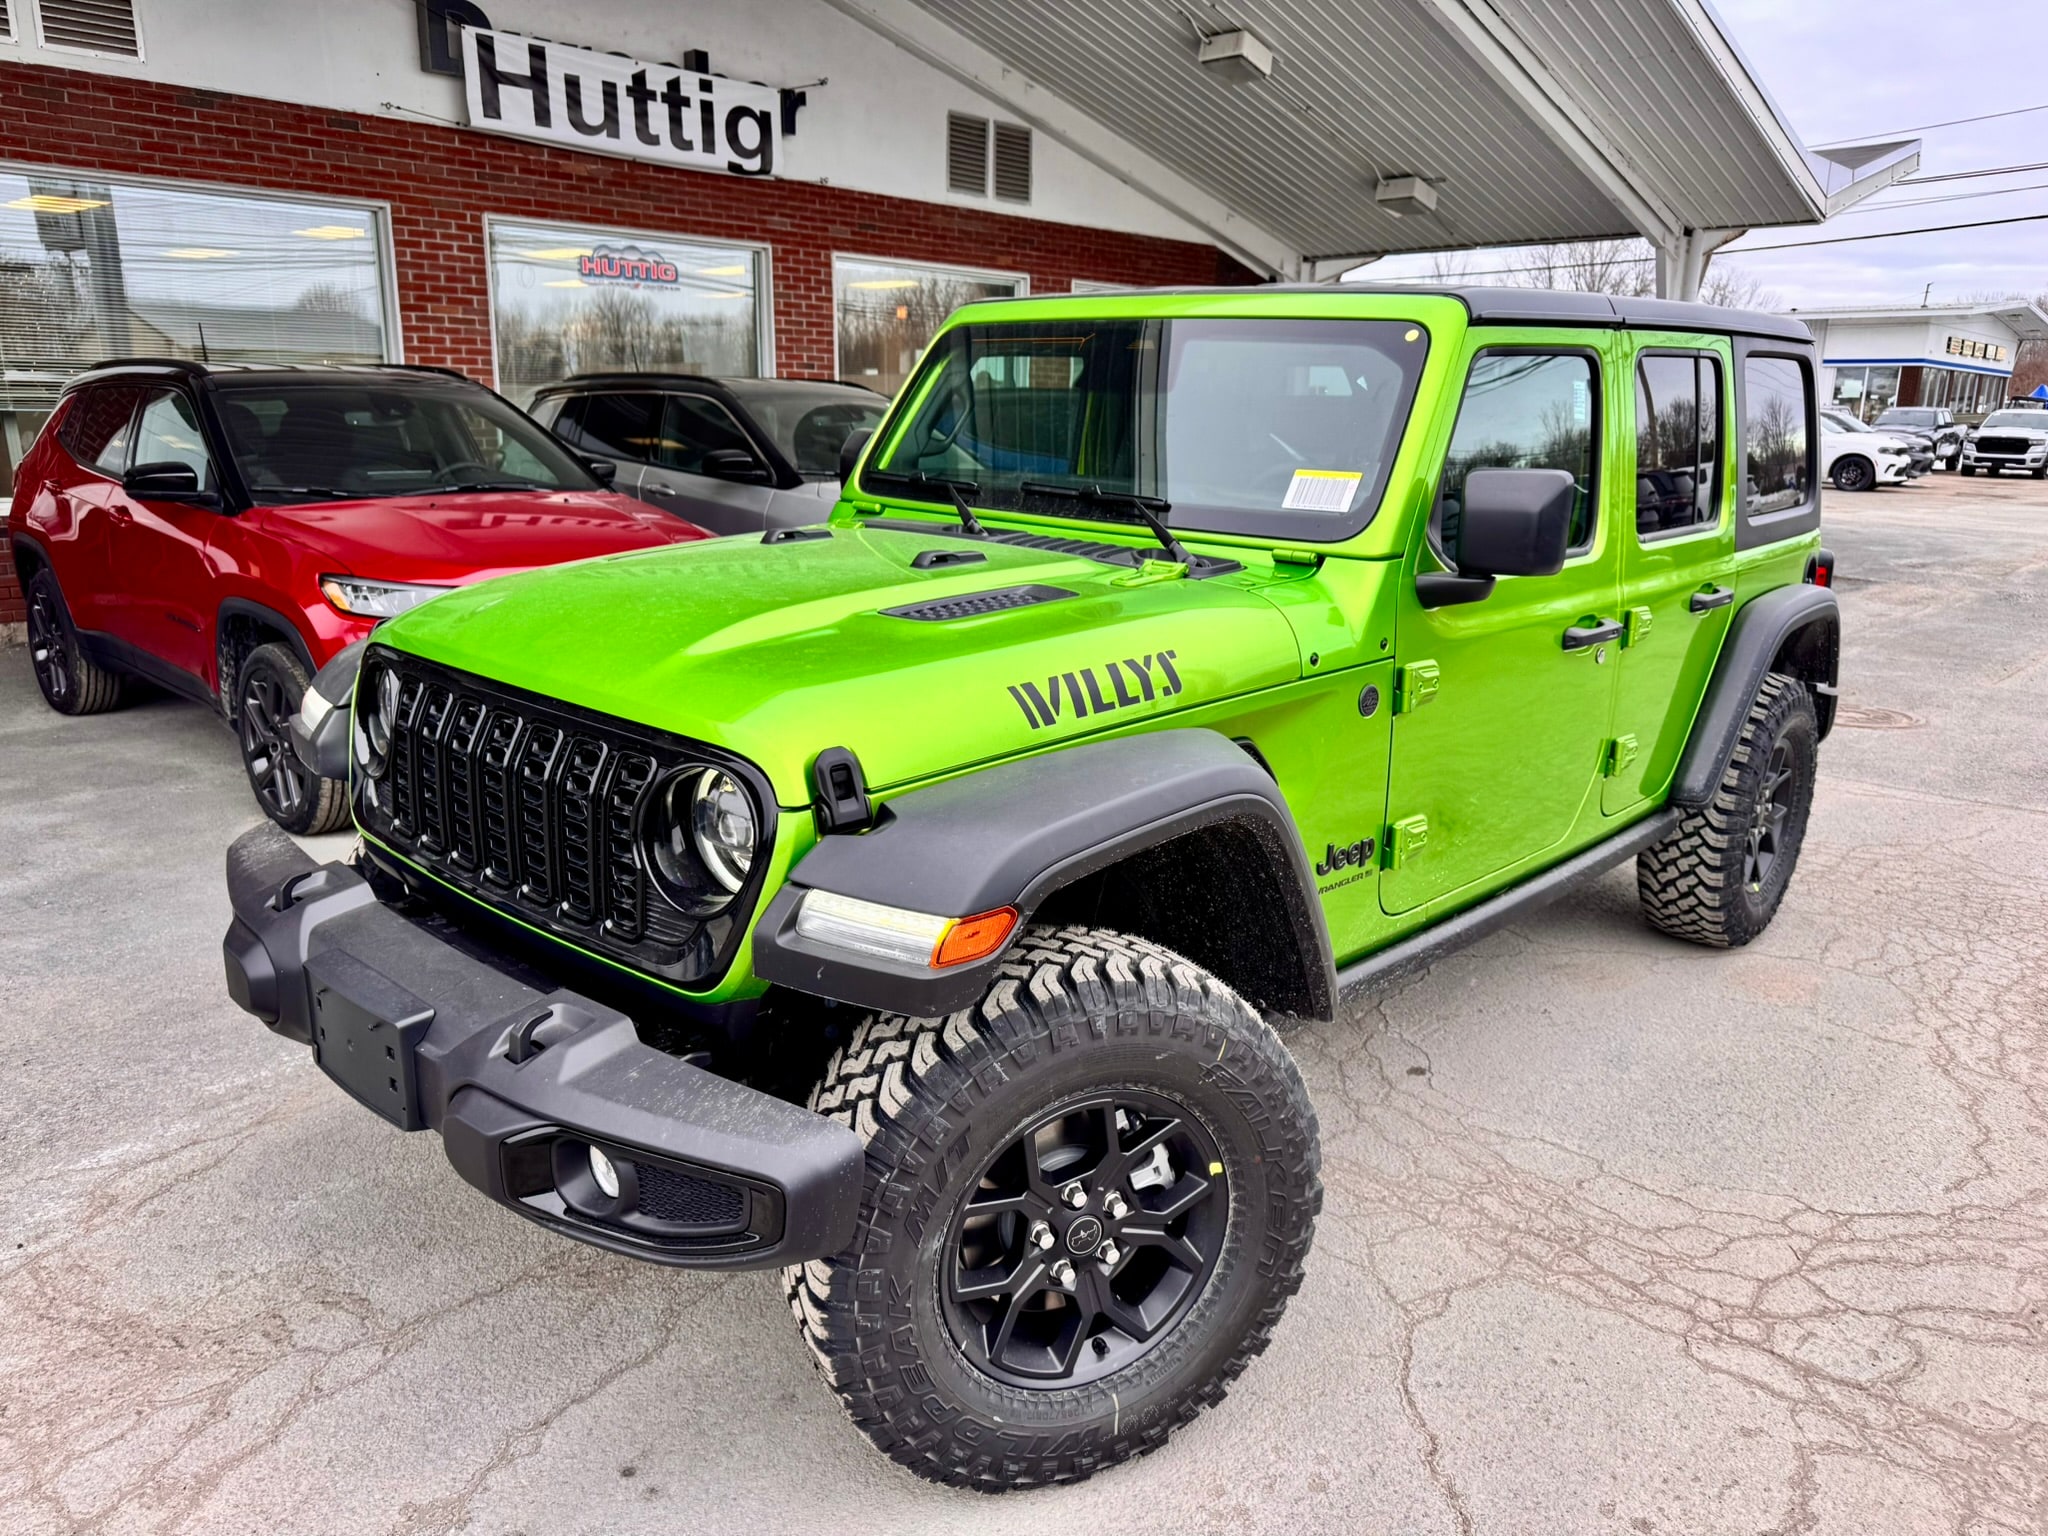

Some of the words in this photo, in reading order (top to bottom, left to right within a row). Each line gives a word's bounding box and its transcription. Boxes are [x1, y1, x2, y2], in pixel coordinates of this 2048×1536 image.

[474, 32, 773, 175] Huttig
[581, 256, 678, 281] HUTTIG
[1007, 650, 1182, 729] WILLYS
[1316, 836, 1375, 876] Jeep
[1318, 872, 1364, 895] RANGLER
